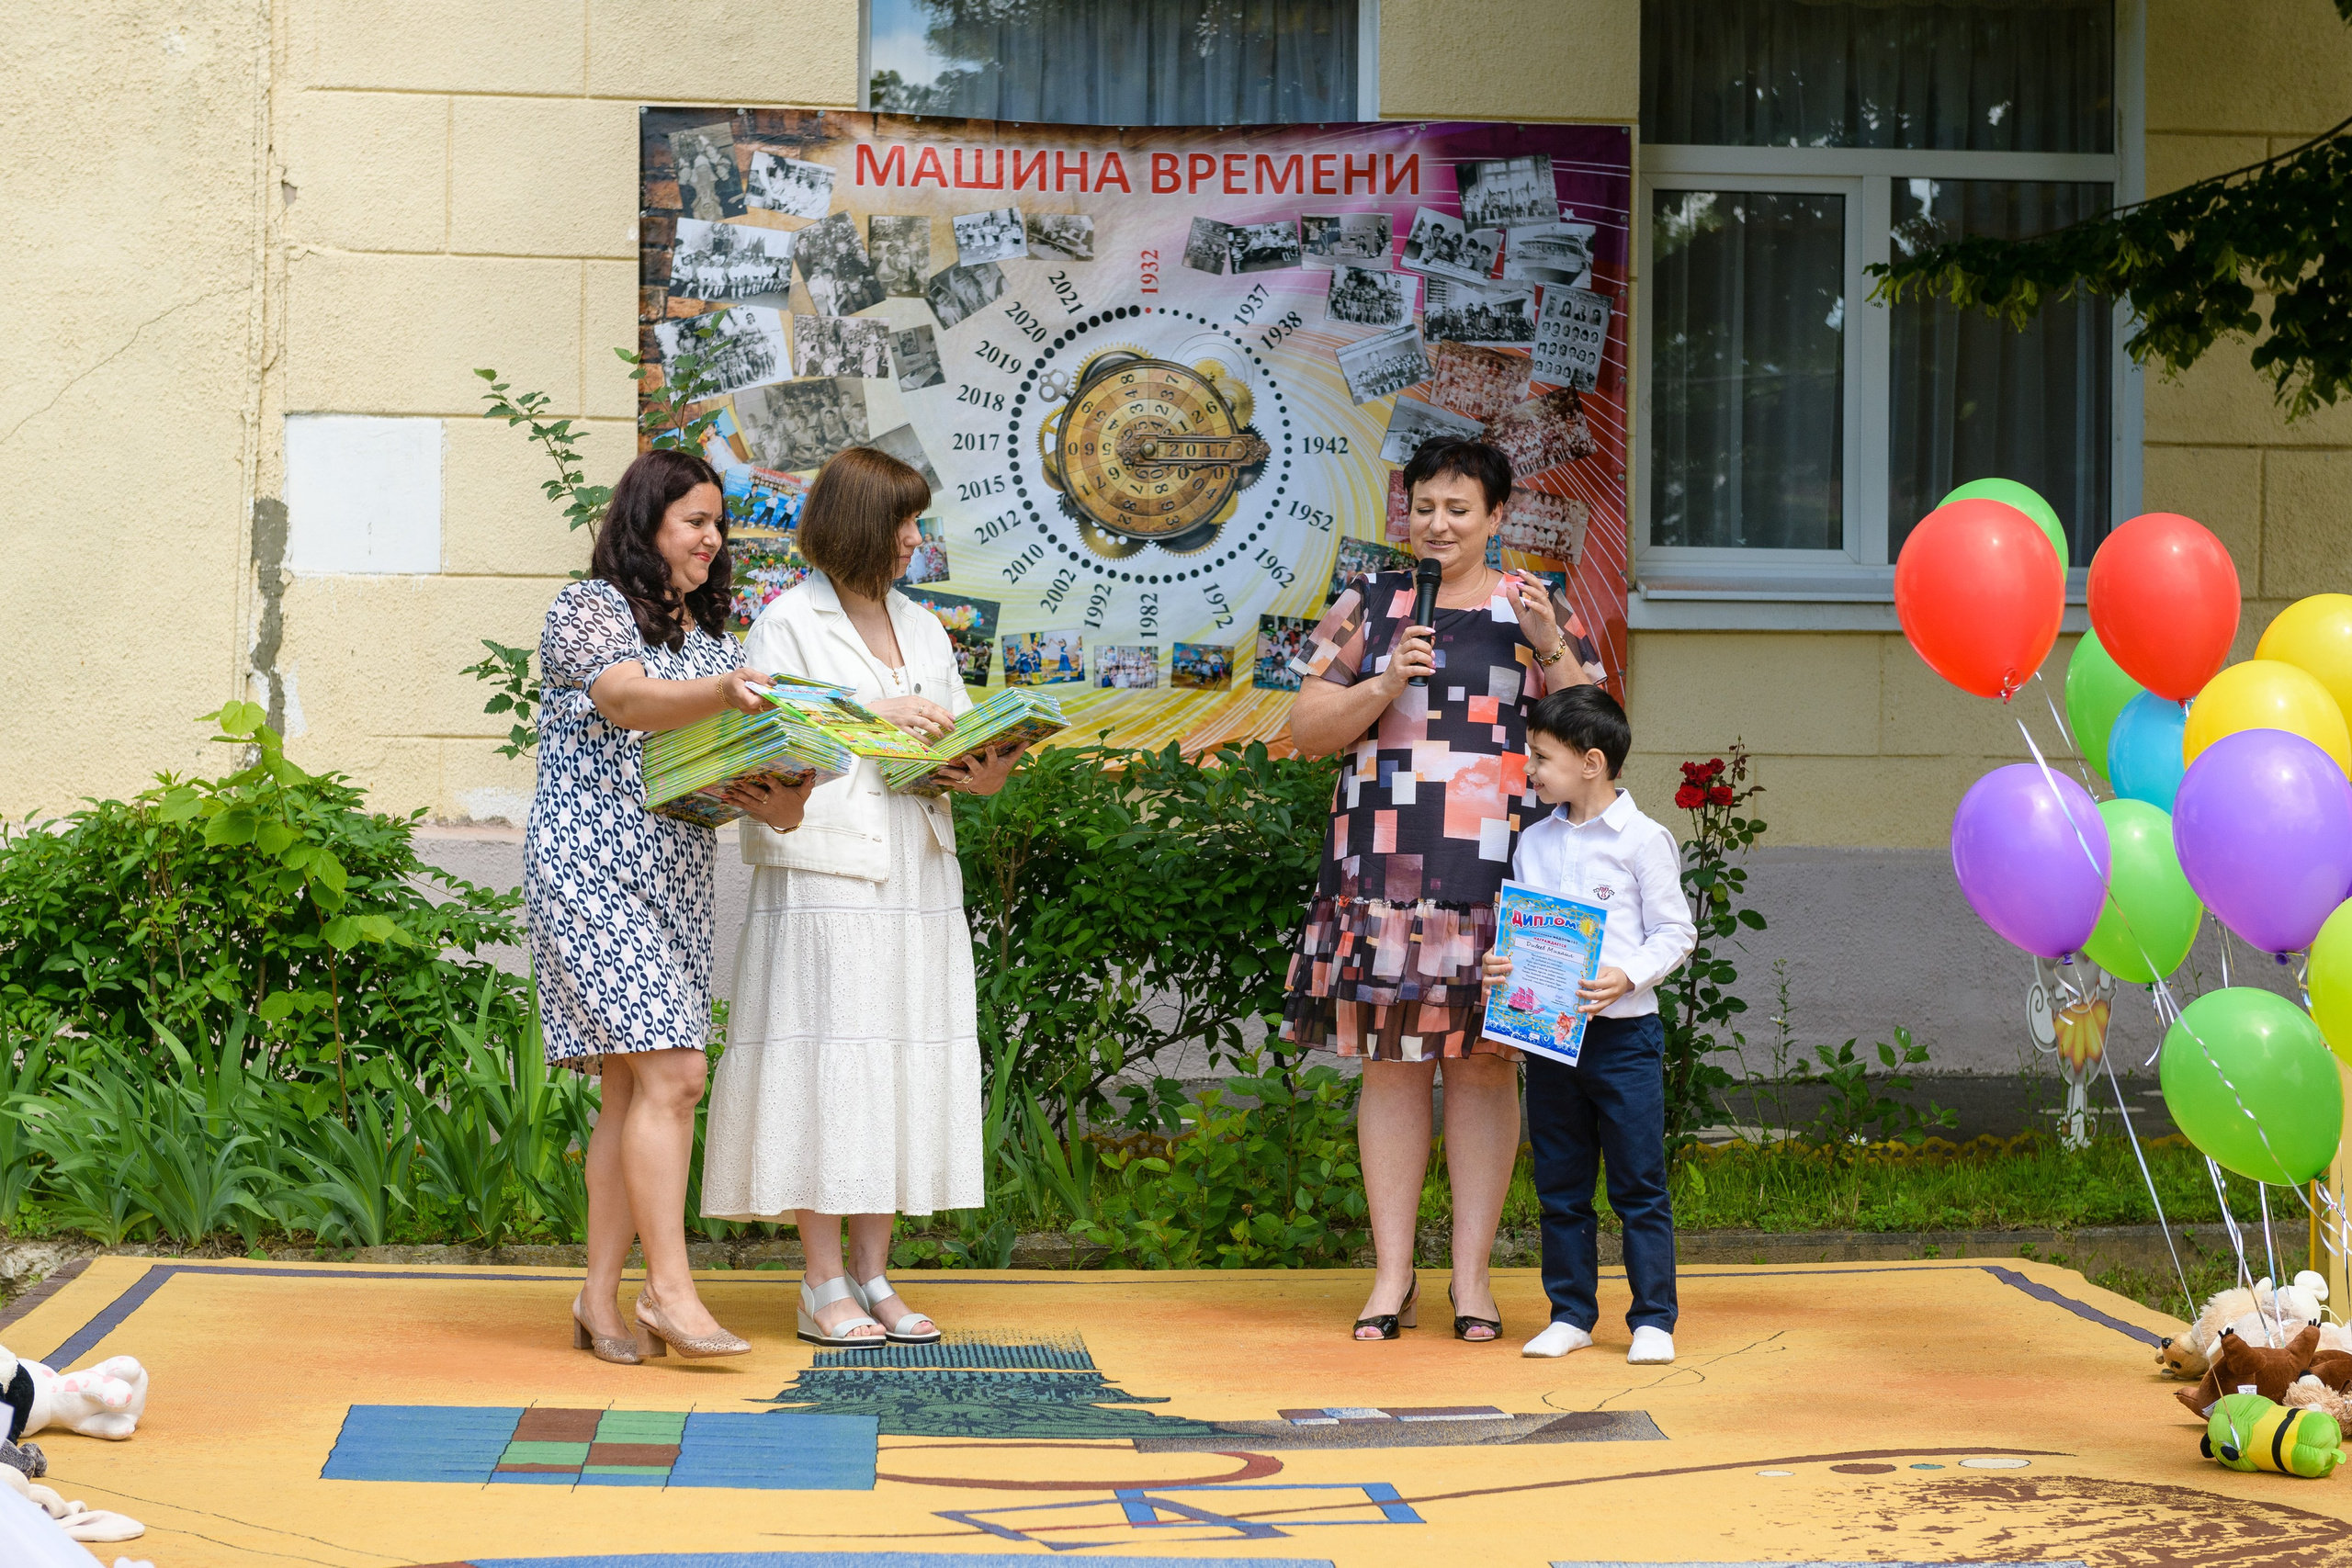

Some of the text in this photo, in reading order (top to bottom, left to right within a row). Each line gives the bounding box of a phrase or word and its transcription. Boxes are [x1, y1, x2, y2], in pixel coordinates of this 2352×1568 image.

[855, 143, 1420, 196] МАШИНА ВРЕМЕНИ
[1047, 270, 1084, 315] 2021
[1139, 248, 1159, 295] 1932
[1004, 300, 1047, 344] 2020
[1234, 282, 1270, 326] 1937
[1260, 310, 1303, 351] 1938
[974, 340, 1022, 375] 2019
[956, 384, 1005, 412] 2018
[952, 433, 1001, 451] 2017
[1069, 443, 1078, 456] 0
[1302, 436, 1349, 455] 1942
[956, 474, 1006, 502] 2015
[974, 509, 1022, 546] 2012
[1288, 501, 1334, 533] 1952
[1002, 543, 1045, 585] 2010
[1254, 547, 1295, 590] 1962
[1040, 568, 1077, 615] 2002
[1083, 583, 1113, 629] 1992
[1203, 582, 1234, 629] 1972
[1139, 592, 1159, 638] 1982
[1511, 909, 1577, 930] ДИПЛОМ
